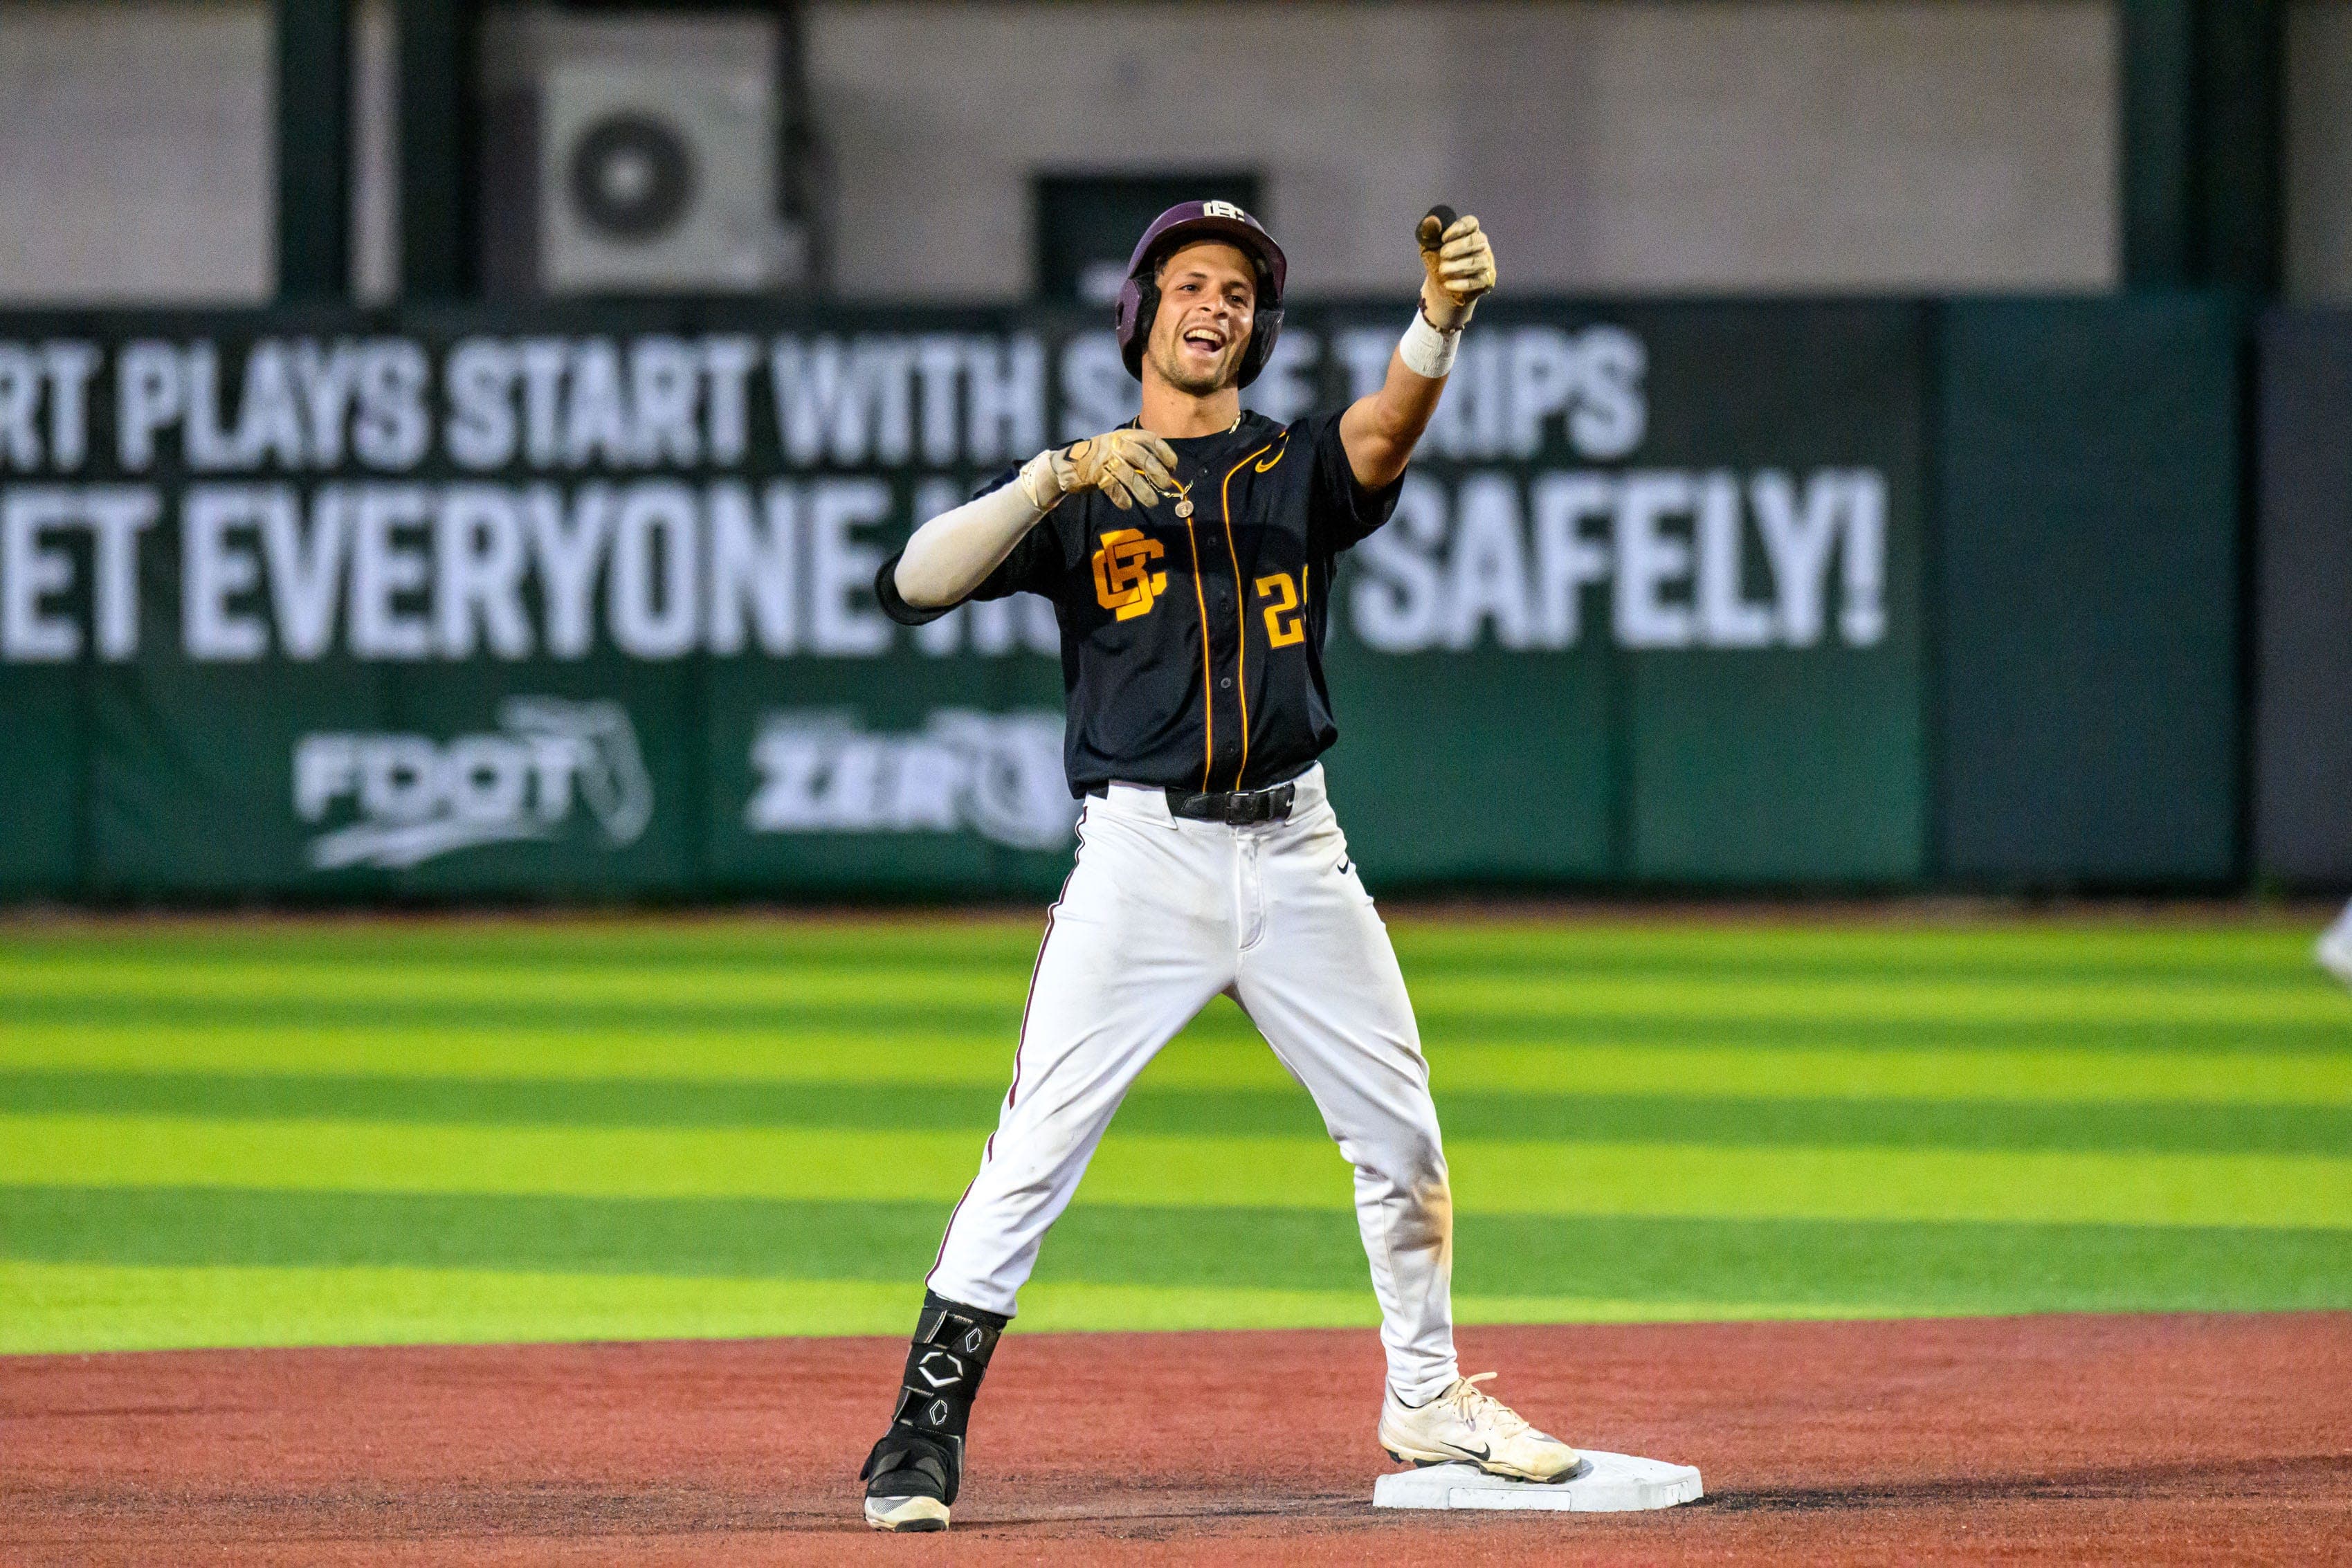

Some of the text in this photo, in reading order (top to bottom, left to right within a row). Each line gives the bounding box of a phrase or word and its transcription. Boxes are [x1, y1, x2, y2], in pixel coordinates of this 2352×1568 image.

[116, 336, 429, 471] PLAYS
[444, 334, 753, 469] START
[769, 331, 1045, 466] WITH
[181, 476, 891, 660] EVERYONE
[1351, 468, 1885, 652] SAFELY!
